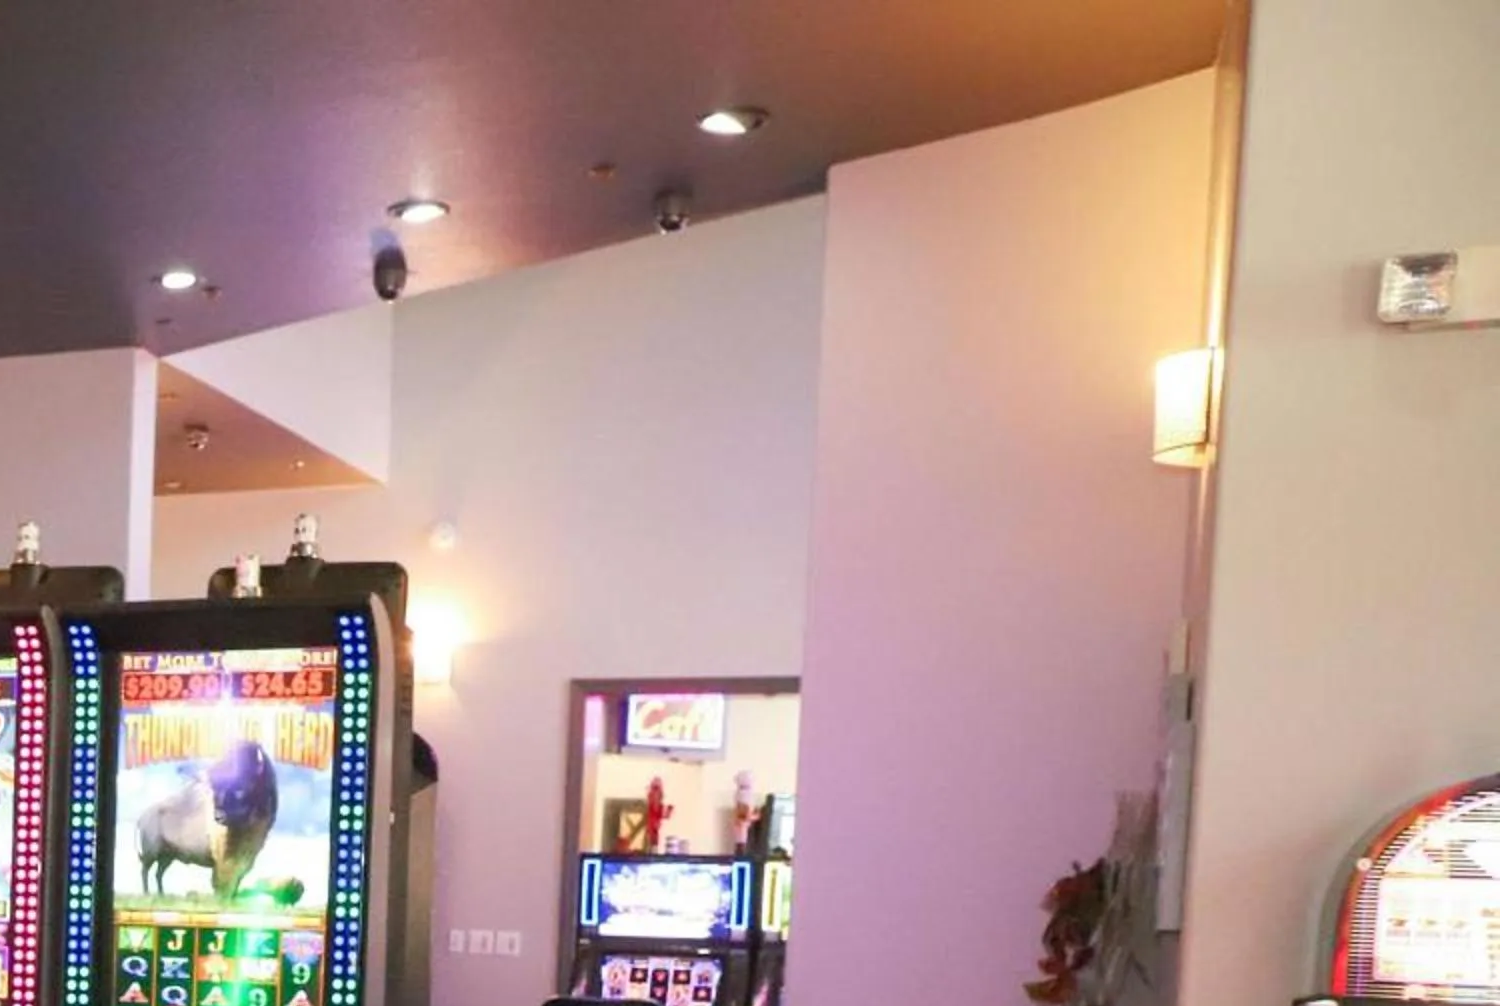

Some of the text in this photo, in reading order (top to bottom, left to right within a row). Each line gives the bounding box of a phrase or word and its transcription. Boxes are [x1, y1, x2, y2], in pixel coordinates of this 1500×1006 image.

[124, 655, 152, 670] BET
[156, 653, 206, 671] MORE
[125, 674, 221, 700] $209.90
[241, 672, 324, 698] $24.65
[274, 710, 334, 772] HERD
